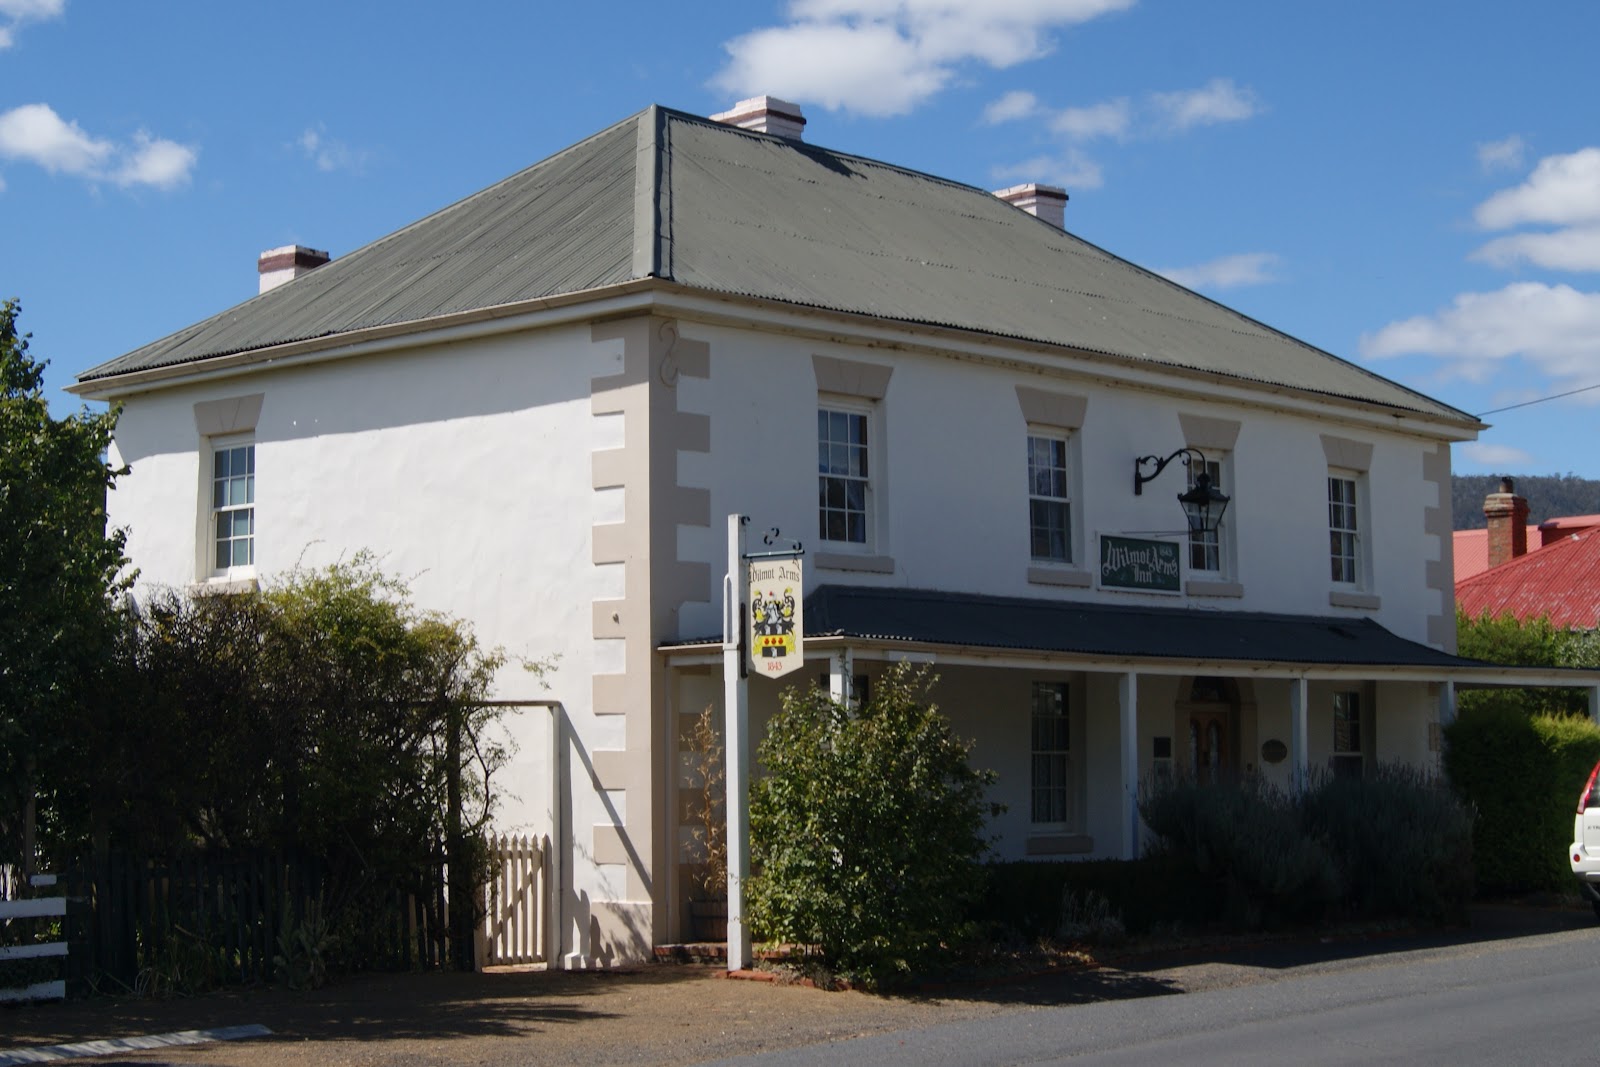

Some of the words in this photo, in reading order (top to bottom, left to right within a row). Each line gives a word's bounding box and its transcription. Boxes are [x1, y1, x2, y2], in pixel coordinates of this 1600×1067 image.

[1102, 540, 1150, 576] Wilmot
[1148, 546, 1178, 577] Arms
[778, 566, 800, 582] Arms
[1131, 563, 1152, 583] Inn
[767, 661, 783, 671] 1843
